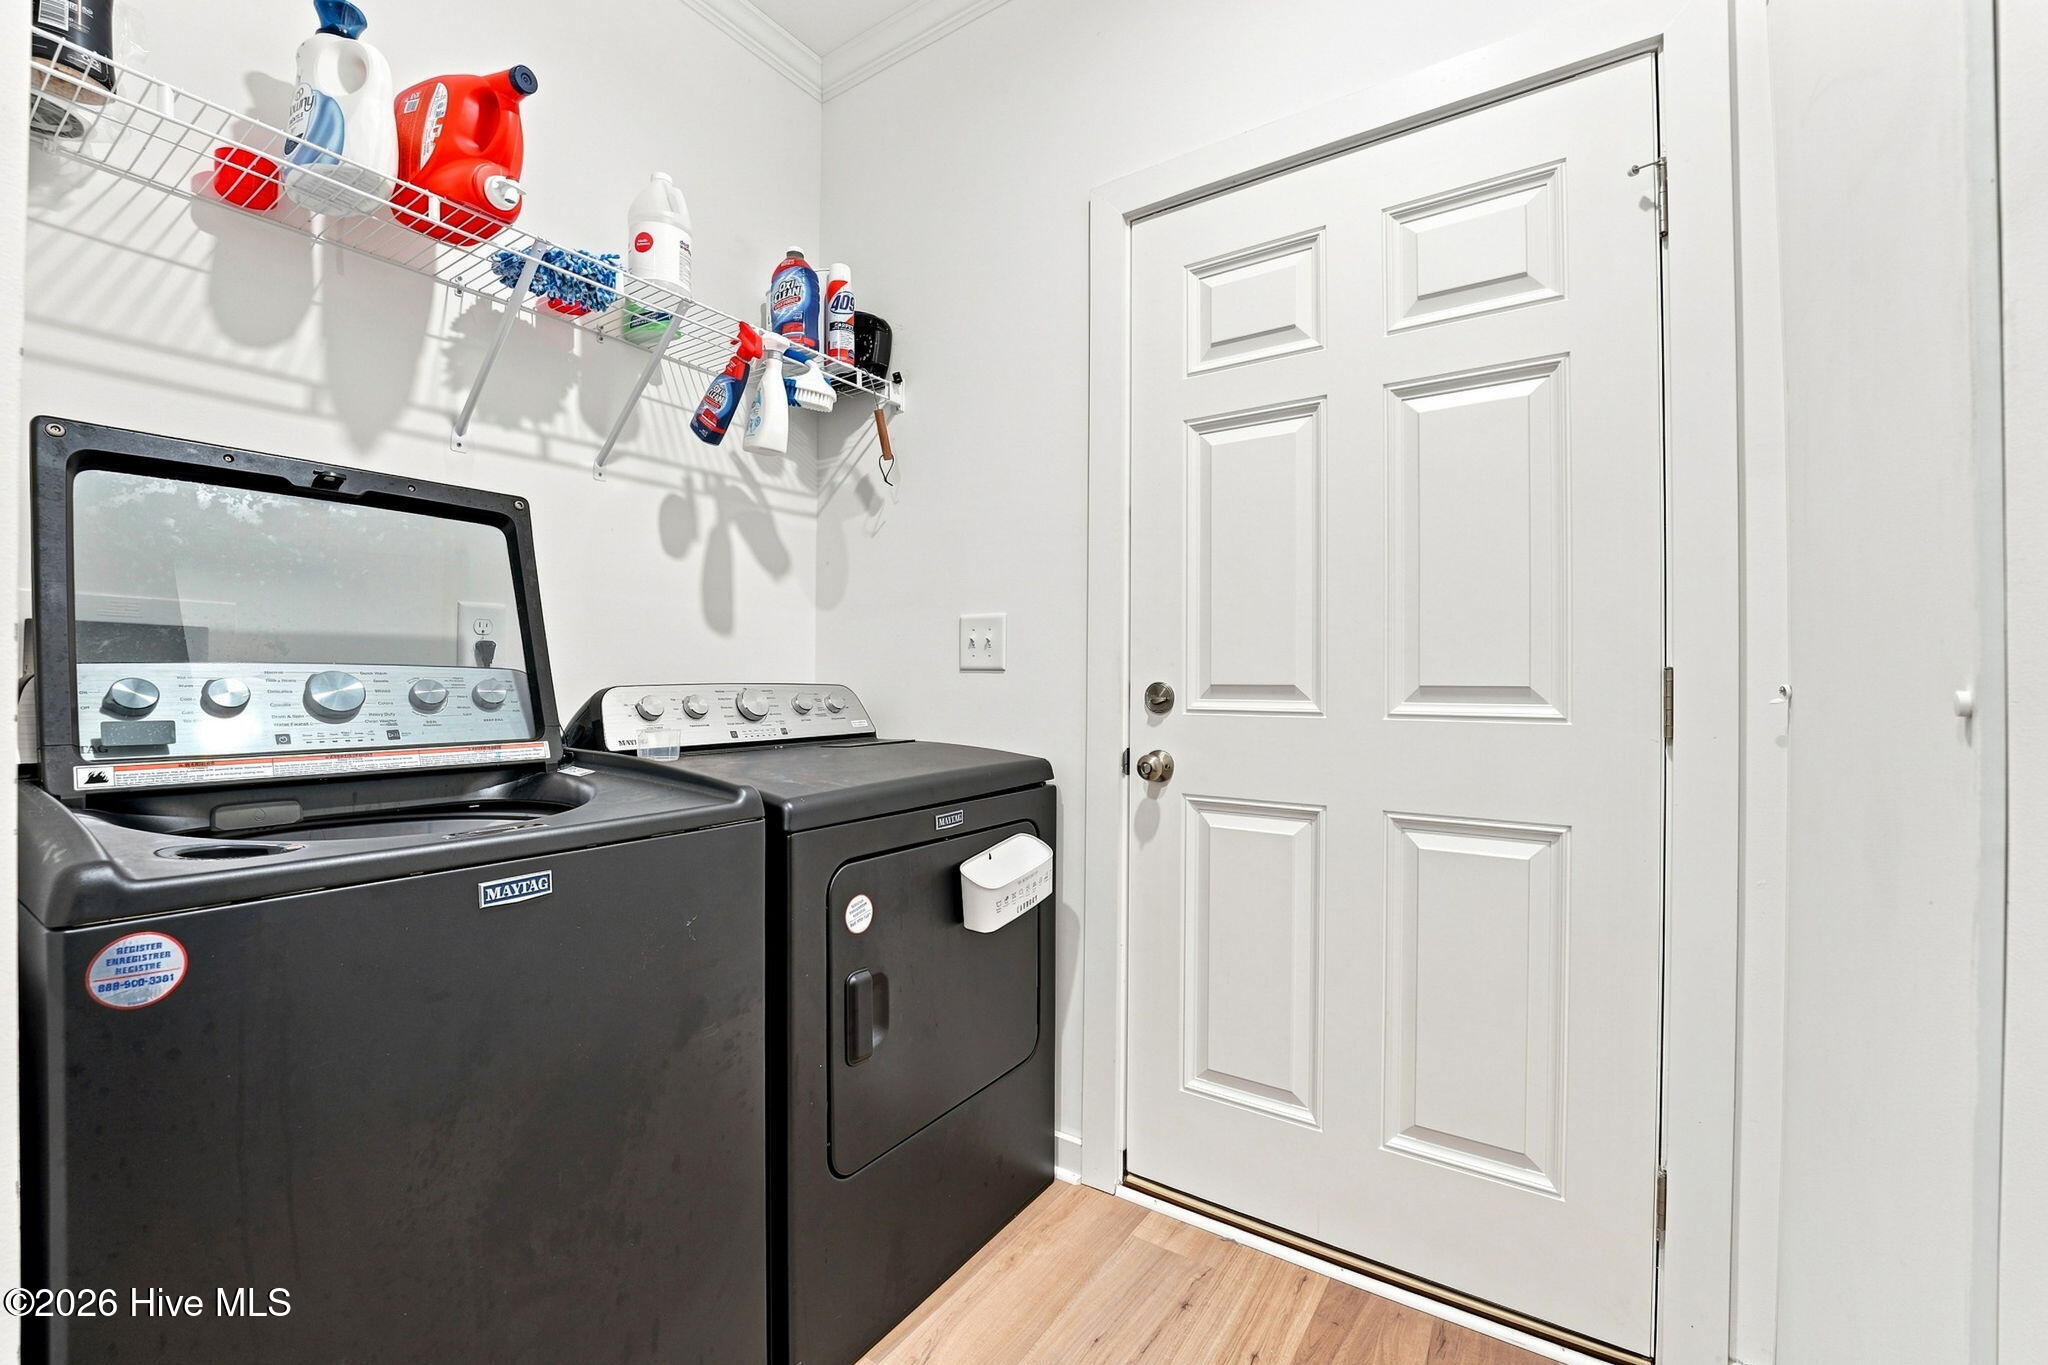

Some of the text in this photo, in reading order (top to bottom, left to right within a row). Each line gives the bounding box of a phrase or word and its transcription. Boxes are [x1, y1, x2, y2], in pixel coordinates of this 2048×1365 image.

[778, 279, 798, 291] OXI
[485, 877, 549, 902] MAYTAG
[116, 942, 163, 955] REGISTER
[106, 950, 171, 967] ENREGISTRER
[115, 961, 162, 975] REGISTRE
